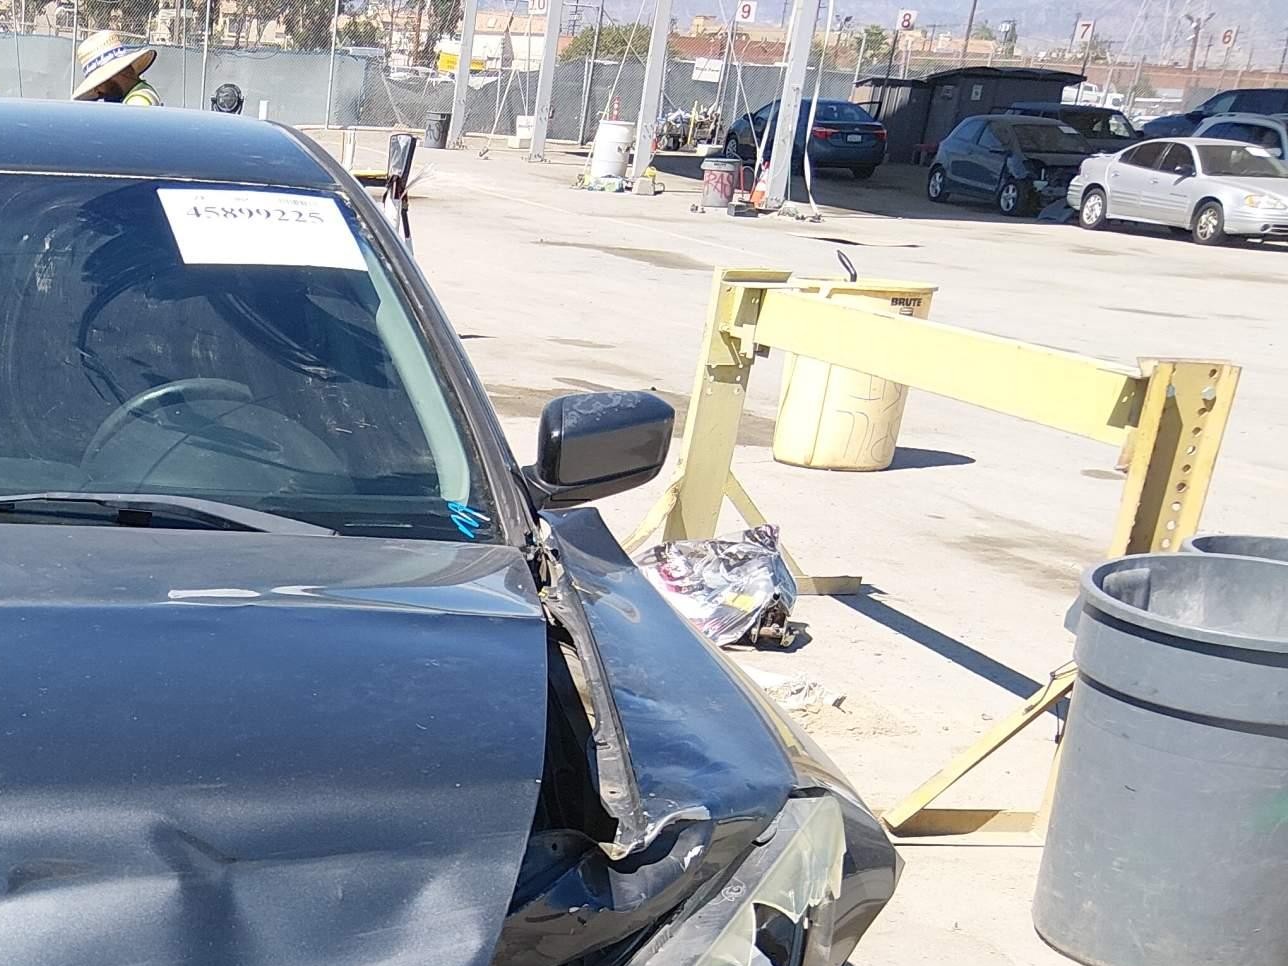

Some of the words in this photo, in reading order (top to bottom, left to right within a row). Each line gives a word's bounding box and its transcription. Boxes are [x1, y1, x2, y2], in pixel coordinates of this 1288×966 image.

[741, 3, 752, 20] 9
[901, 12, 913, 29] 8
[1080, 23, 1092, 39] 7
[1222, 29, 1233, 45] 6
[186, 206, 325, 224] 45899225
[891, 297, 923, 307] BRUTE
